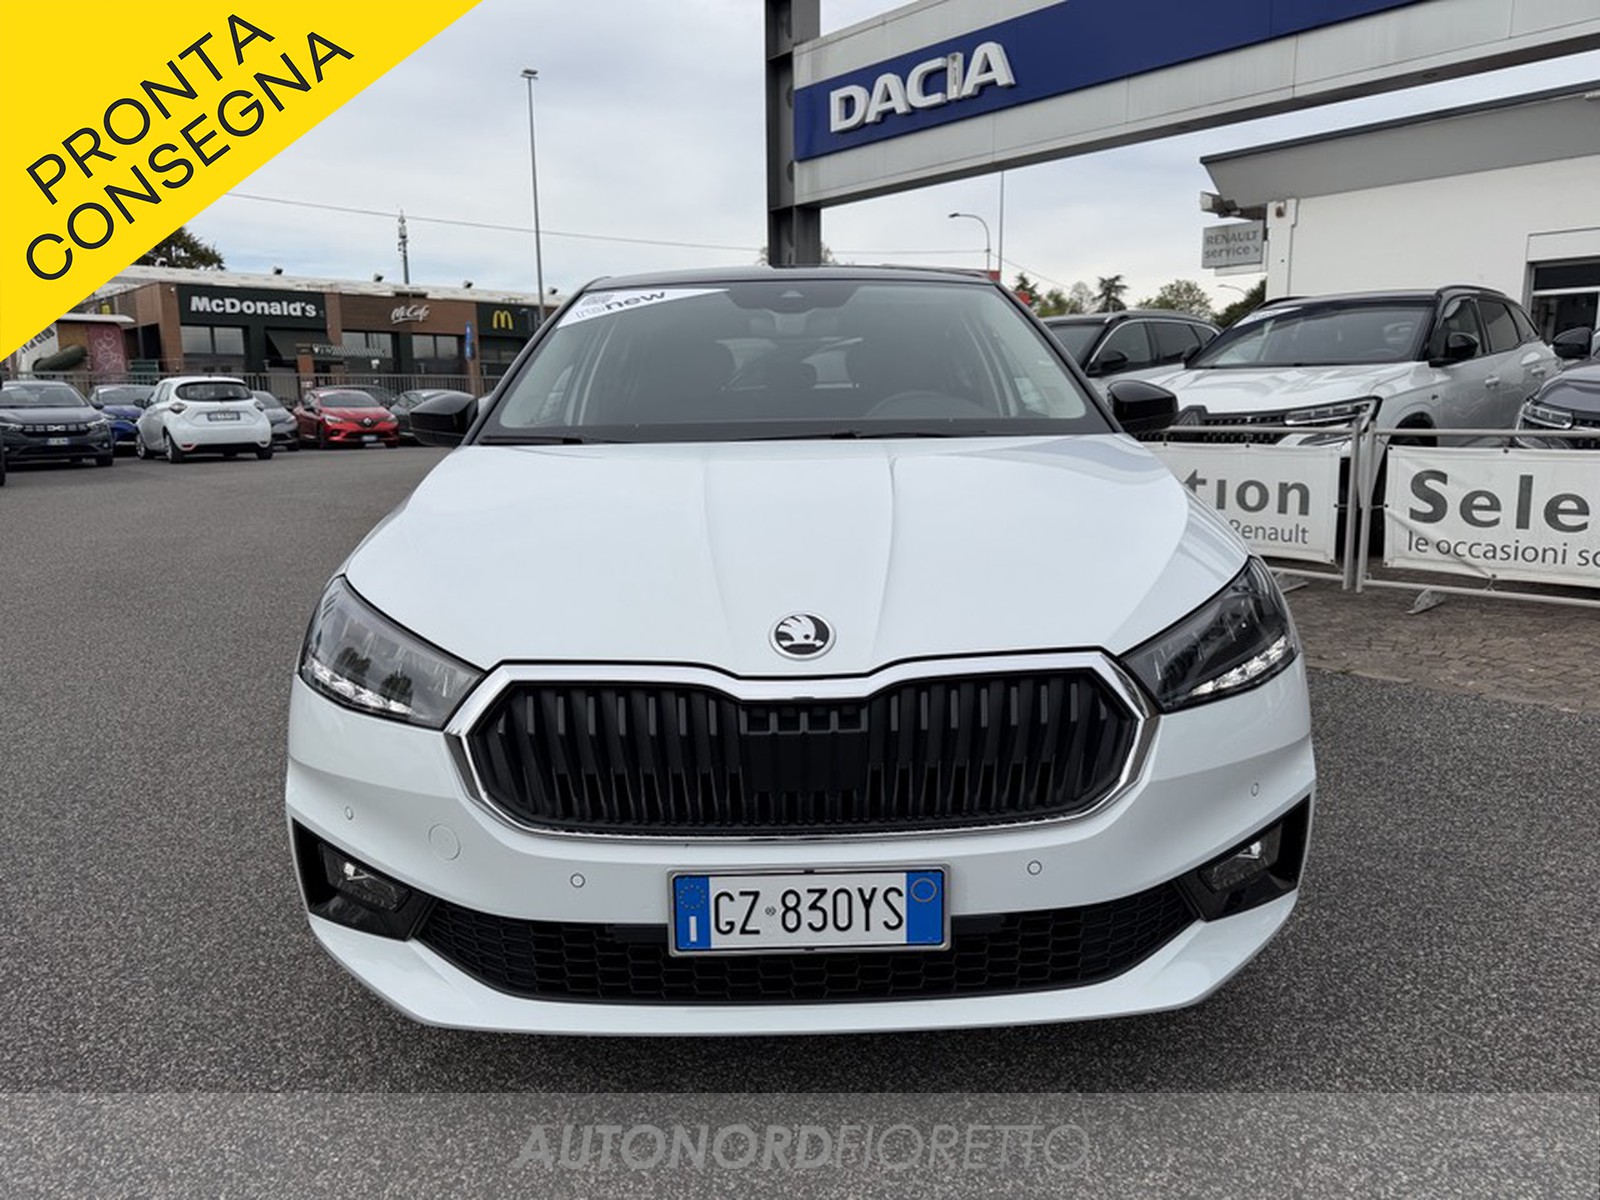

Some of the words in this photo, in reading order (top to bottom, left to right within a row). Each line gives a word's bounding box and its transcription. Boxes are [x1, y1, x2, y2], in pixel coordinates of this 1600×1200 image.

[830, 41, 1015, 133] DACIA
[1205, 245, 1251, 259] service
[1206, 230, 1259, 245] RENAULT
[190, 295, 317, 318] McDonald's
[1408, 469, 1590, 533] Sele
[1408, 530, 1430, 553] le
[1435, 540, 1568, 565] occasioni
[713, 890, 761, 935] GZ
[780, 886, 905, 933] 830YS
